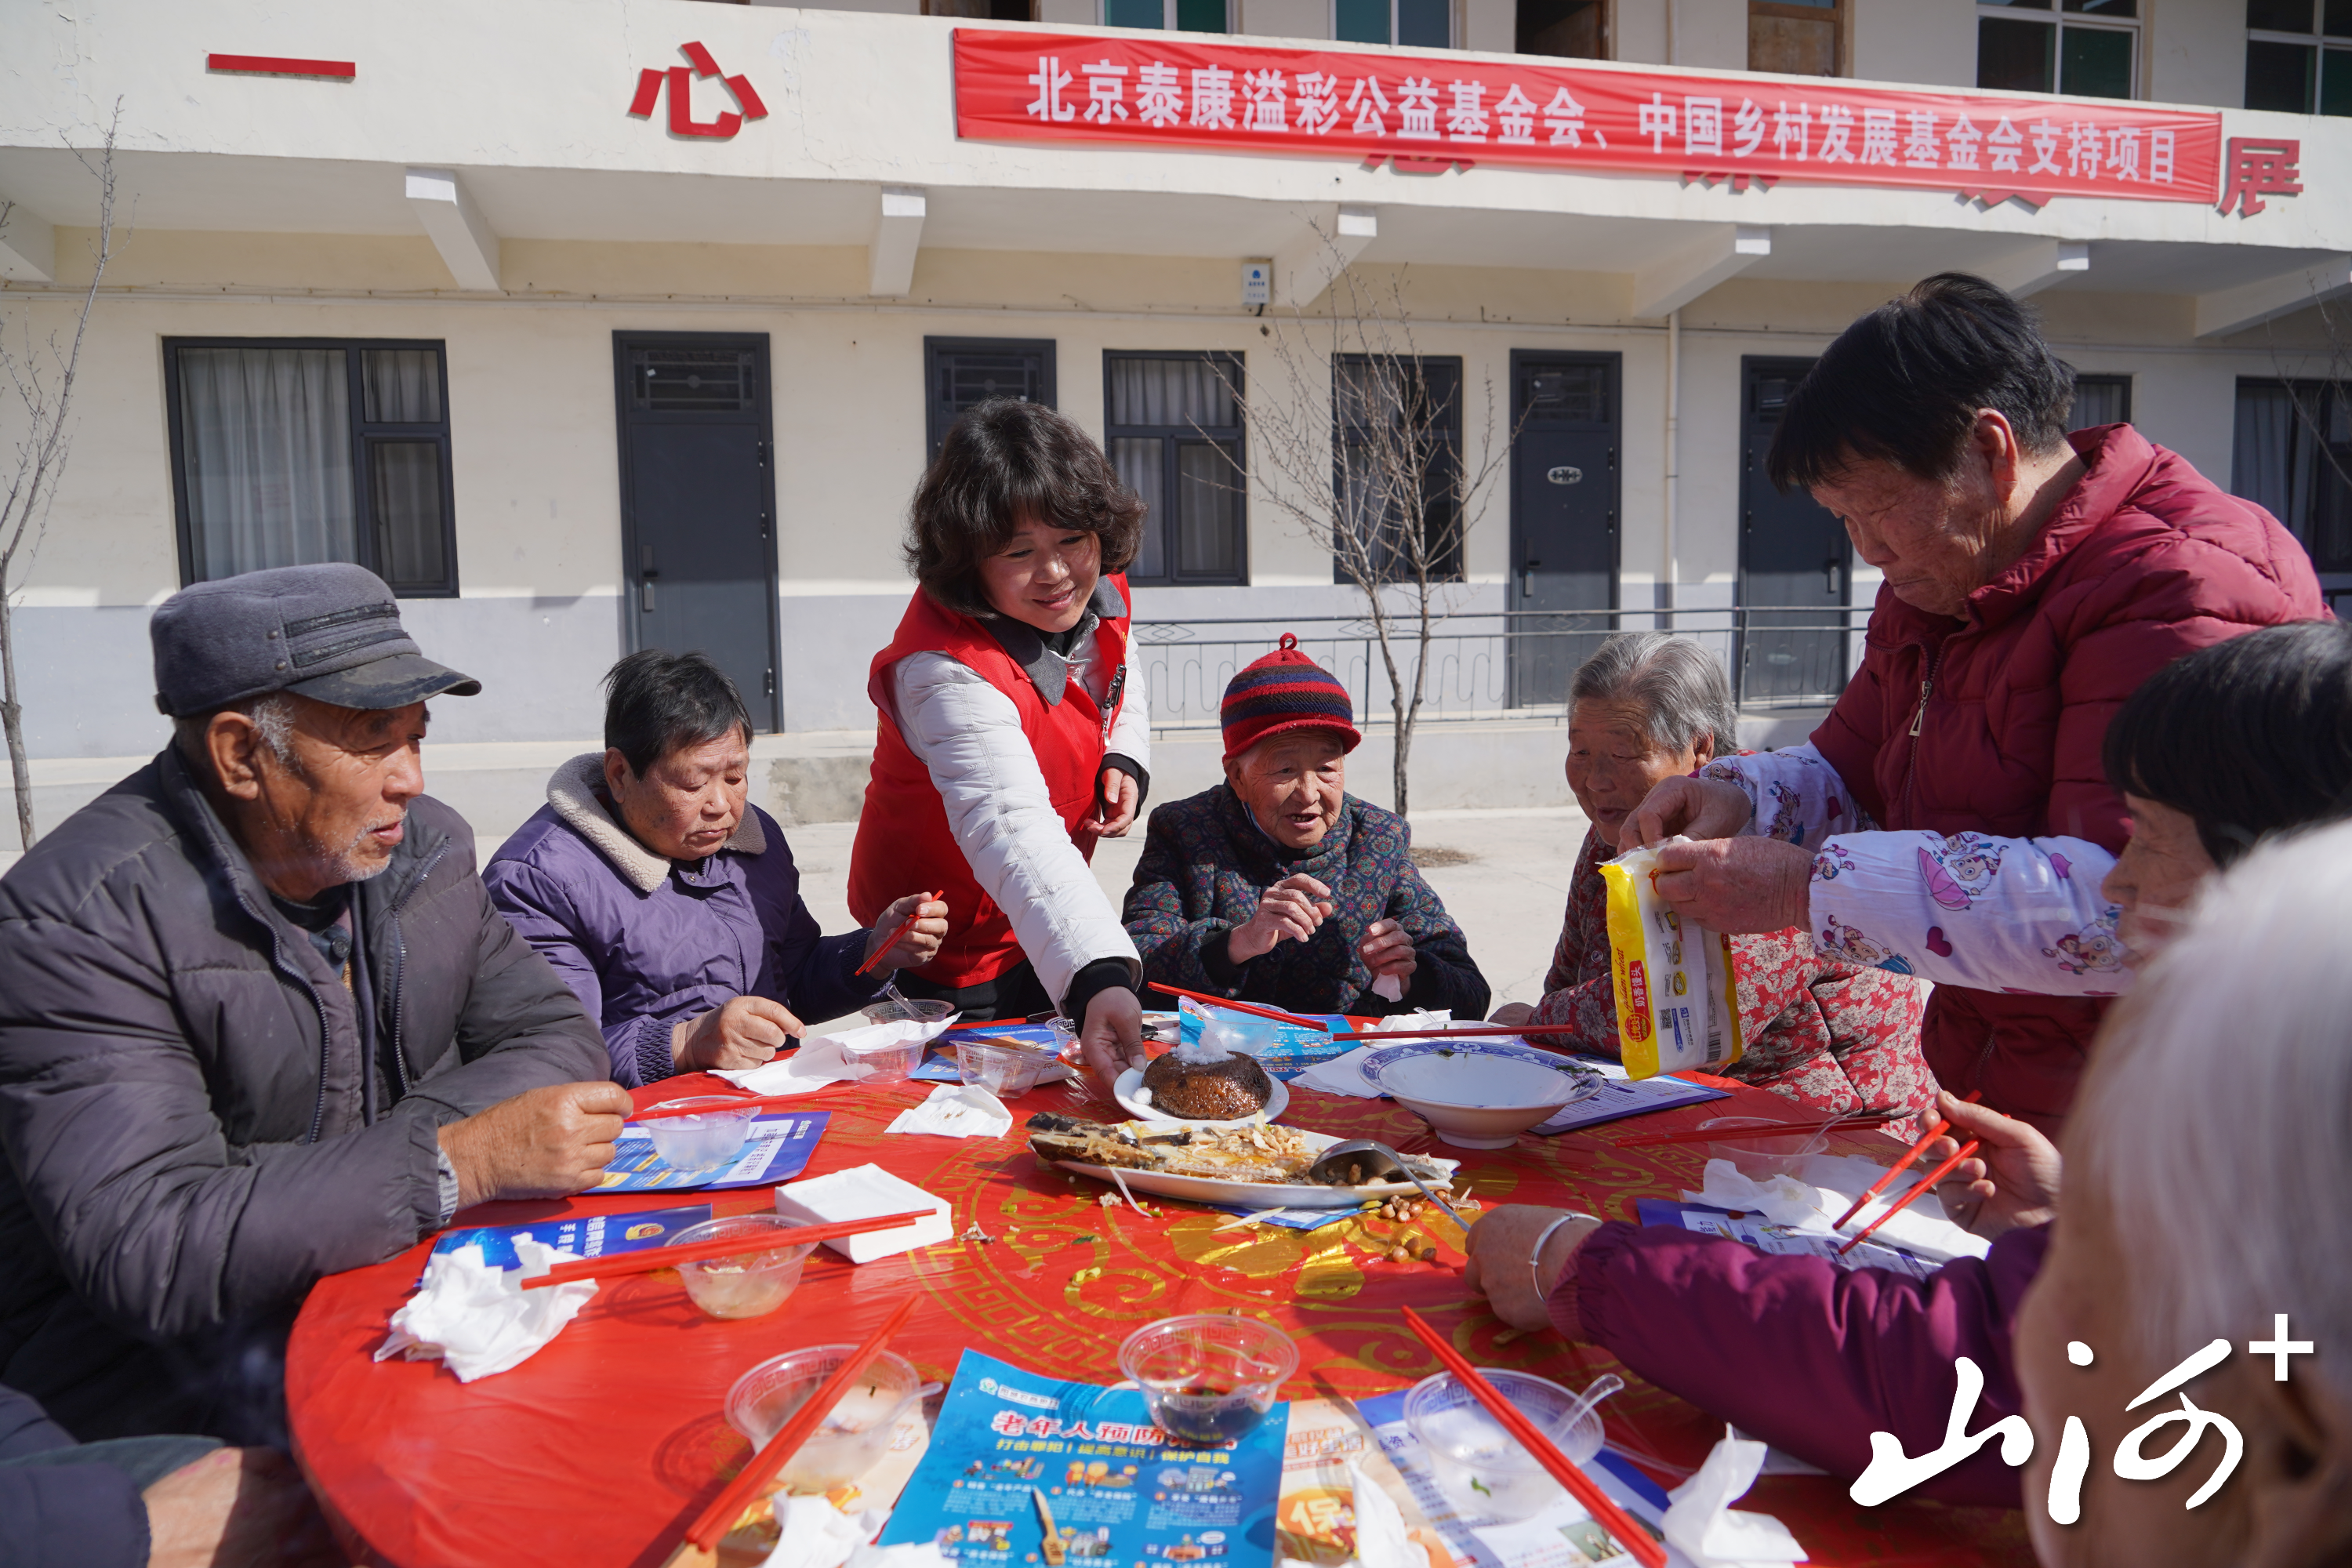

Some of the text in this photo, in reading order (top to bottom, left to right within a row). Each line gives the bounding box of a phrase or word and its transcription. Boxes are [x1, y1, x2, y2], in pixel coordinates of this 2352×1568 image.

[630, 41, 768, 137] 心
[1027, 56, 2176, 184] 北京泰康溢彩公益基金会、中国乡村发展基金会支持项目
[2219, 137, 2303, 218] 展
[1614, 947, 1626, 975] wheat
[1631, 966, 1646, 1007] 奶香馒头
[992, 1410, 1238, 1450] 老年人预防
[996, 1439, 1230, 1465] 打击罪犯 提高意识 保护自我
